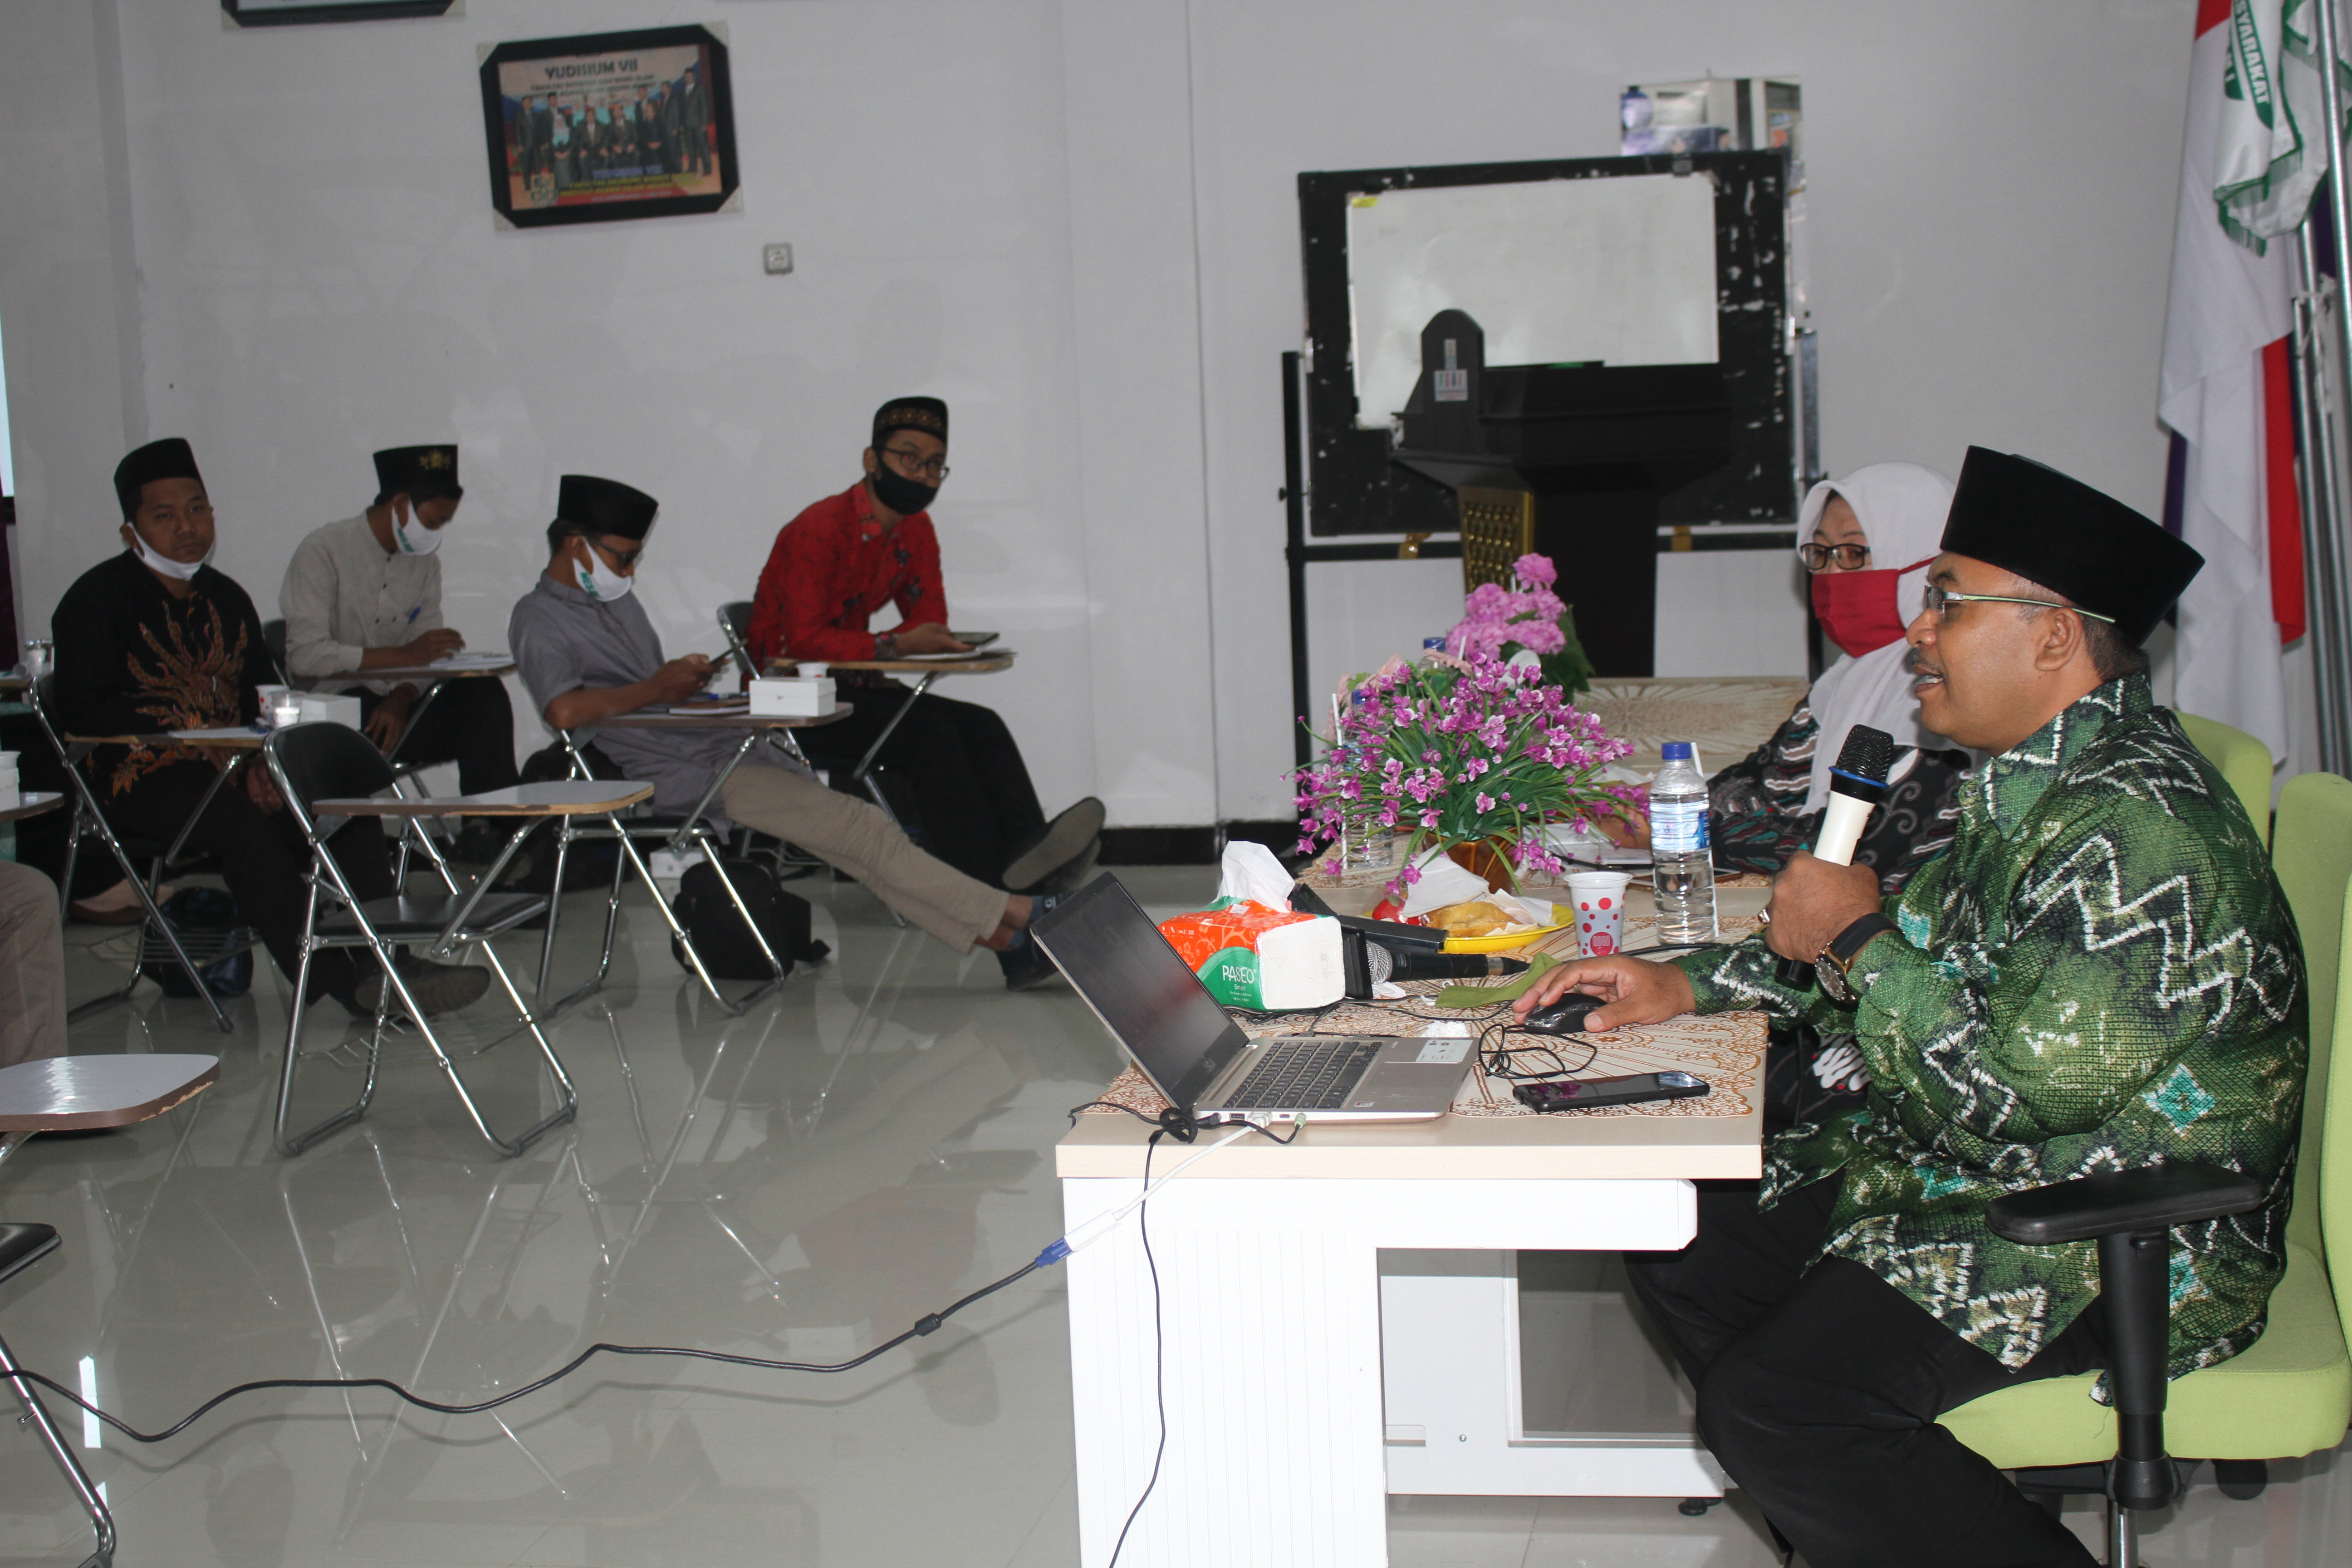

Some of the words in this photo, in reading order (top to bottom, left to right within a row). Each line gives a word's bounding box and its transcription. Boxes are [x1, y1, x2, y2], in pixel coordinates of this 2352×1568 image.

[2235, 0, 2270, 104] SYARAKAT
[545, 60, 614, 80] YUDISIUM
[618, 58, 638, 72] VII
[1222, 965, 1254, 984] PASEO
